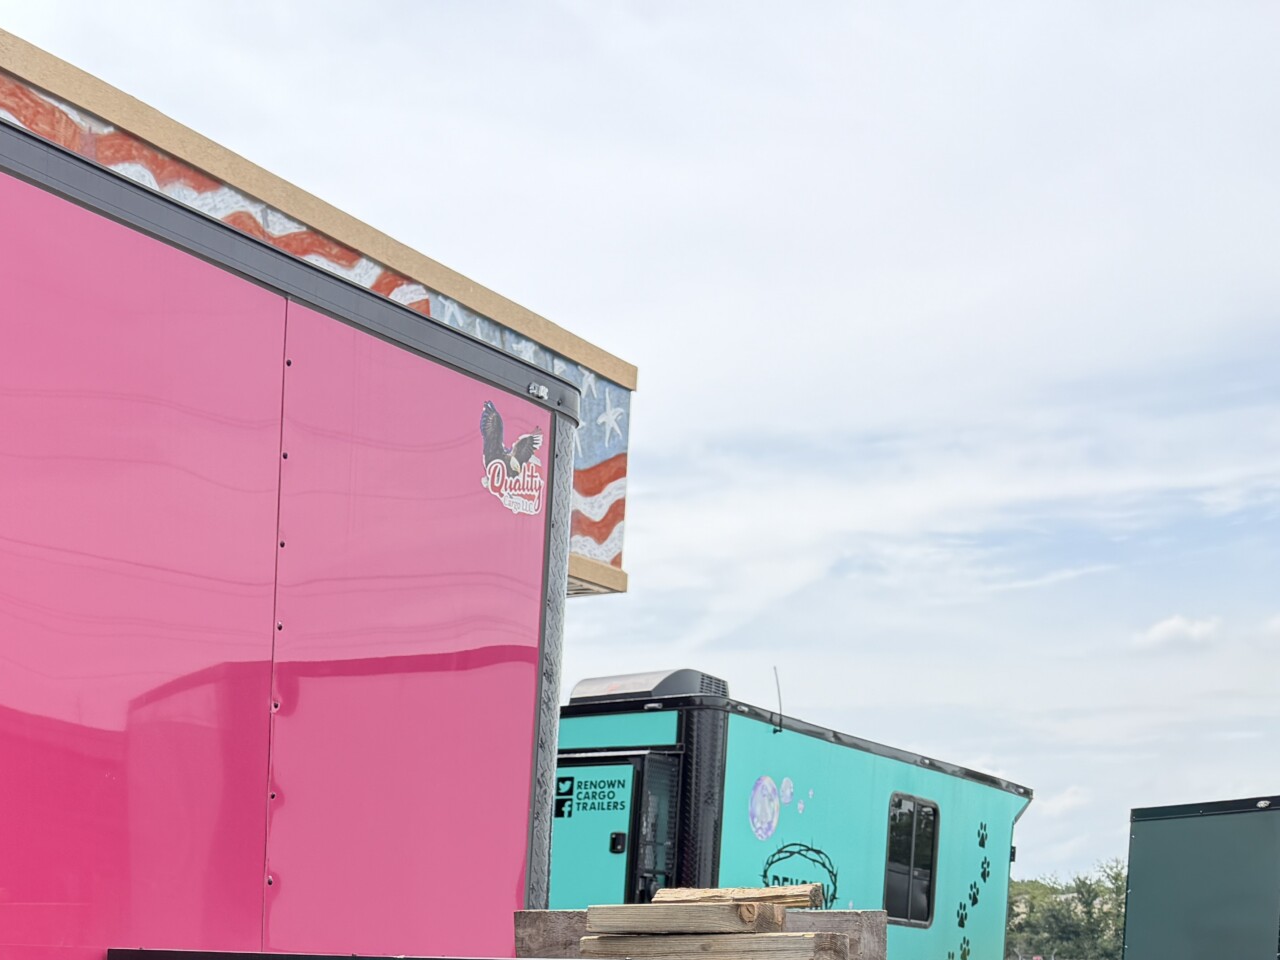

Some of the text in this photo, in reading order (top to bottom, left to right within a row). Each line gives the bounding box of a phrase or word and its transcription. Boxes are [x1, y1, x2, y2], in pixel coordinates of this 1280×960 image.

[488, 461, 542, 512] Quality
[576, 779, 626, 790] RENOWN
[576, 791, 616, 800] CARGO
[576, 801, 626, 812] TRAILERS
